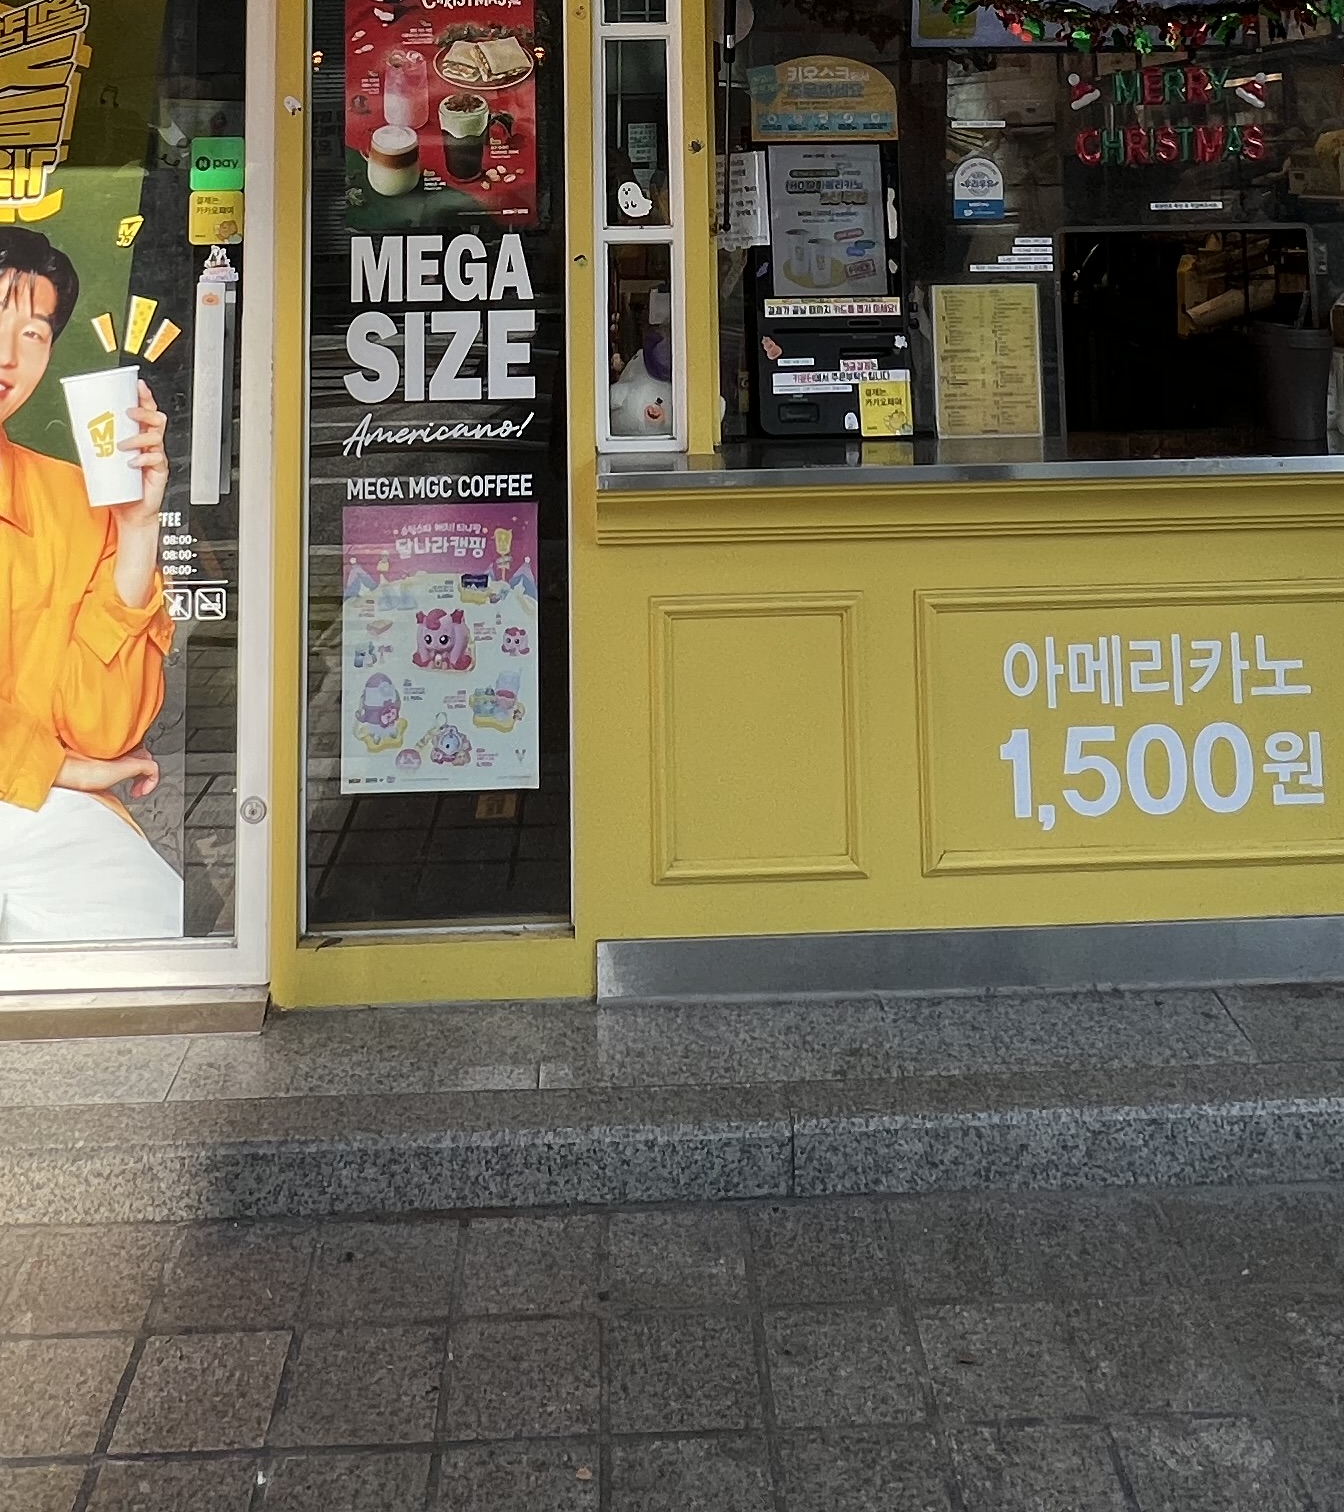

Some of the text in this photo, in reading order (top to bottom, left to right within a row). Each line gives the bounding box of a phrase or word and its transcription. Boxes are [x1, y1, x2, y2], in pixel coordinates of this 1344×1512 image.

[1112, 65, 1231, 106] MERRY
[212, 157, 239, 170] pay
[1074, 124, 1266, 167] CHRISTMAS
[350, 233, 535, 303] MEGA
[342, 308, 537, 404] SIZE
[342, 411, 535, 459] Americano!
[346, 473, 533, 501] MEGA MGC COFFEE
[1003, 632, 1312, 709] 아메리카노
[999, 721, 1325, 832] 1,500원
